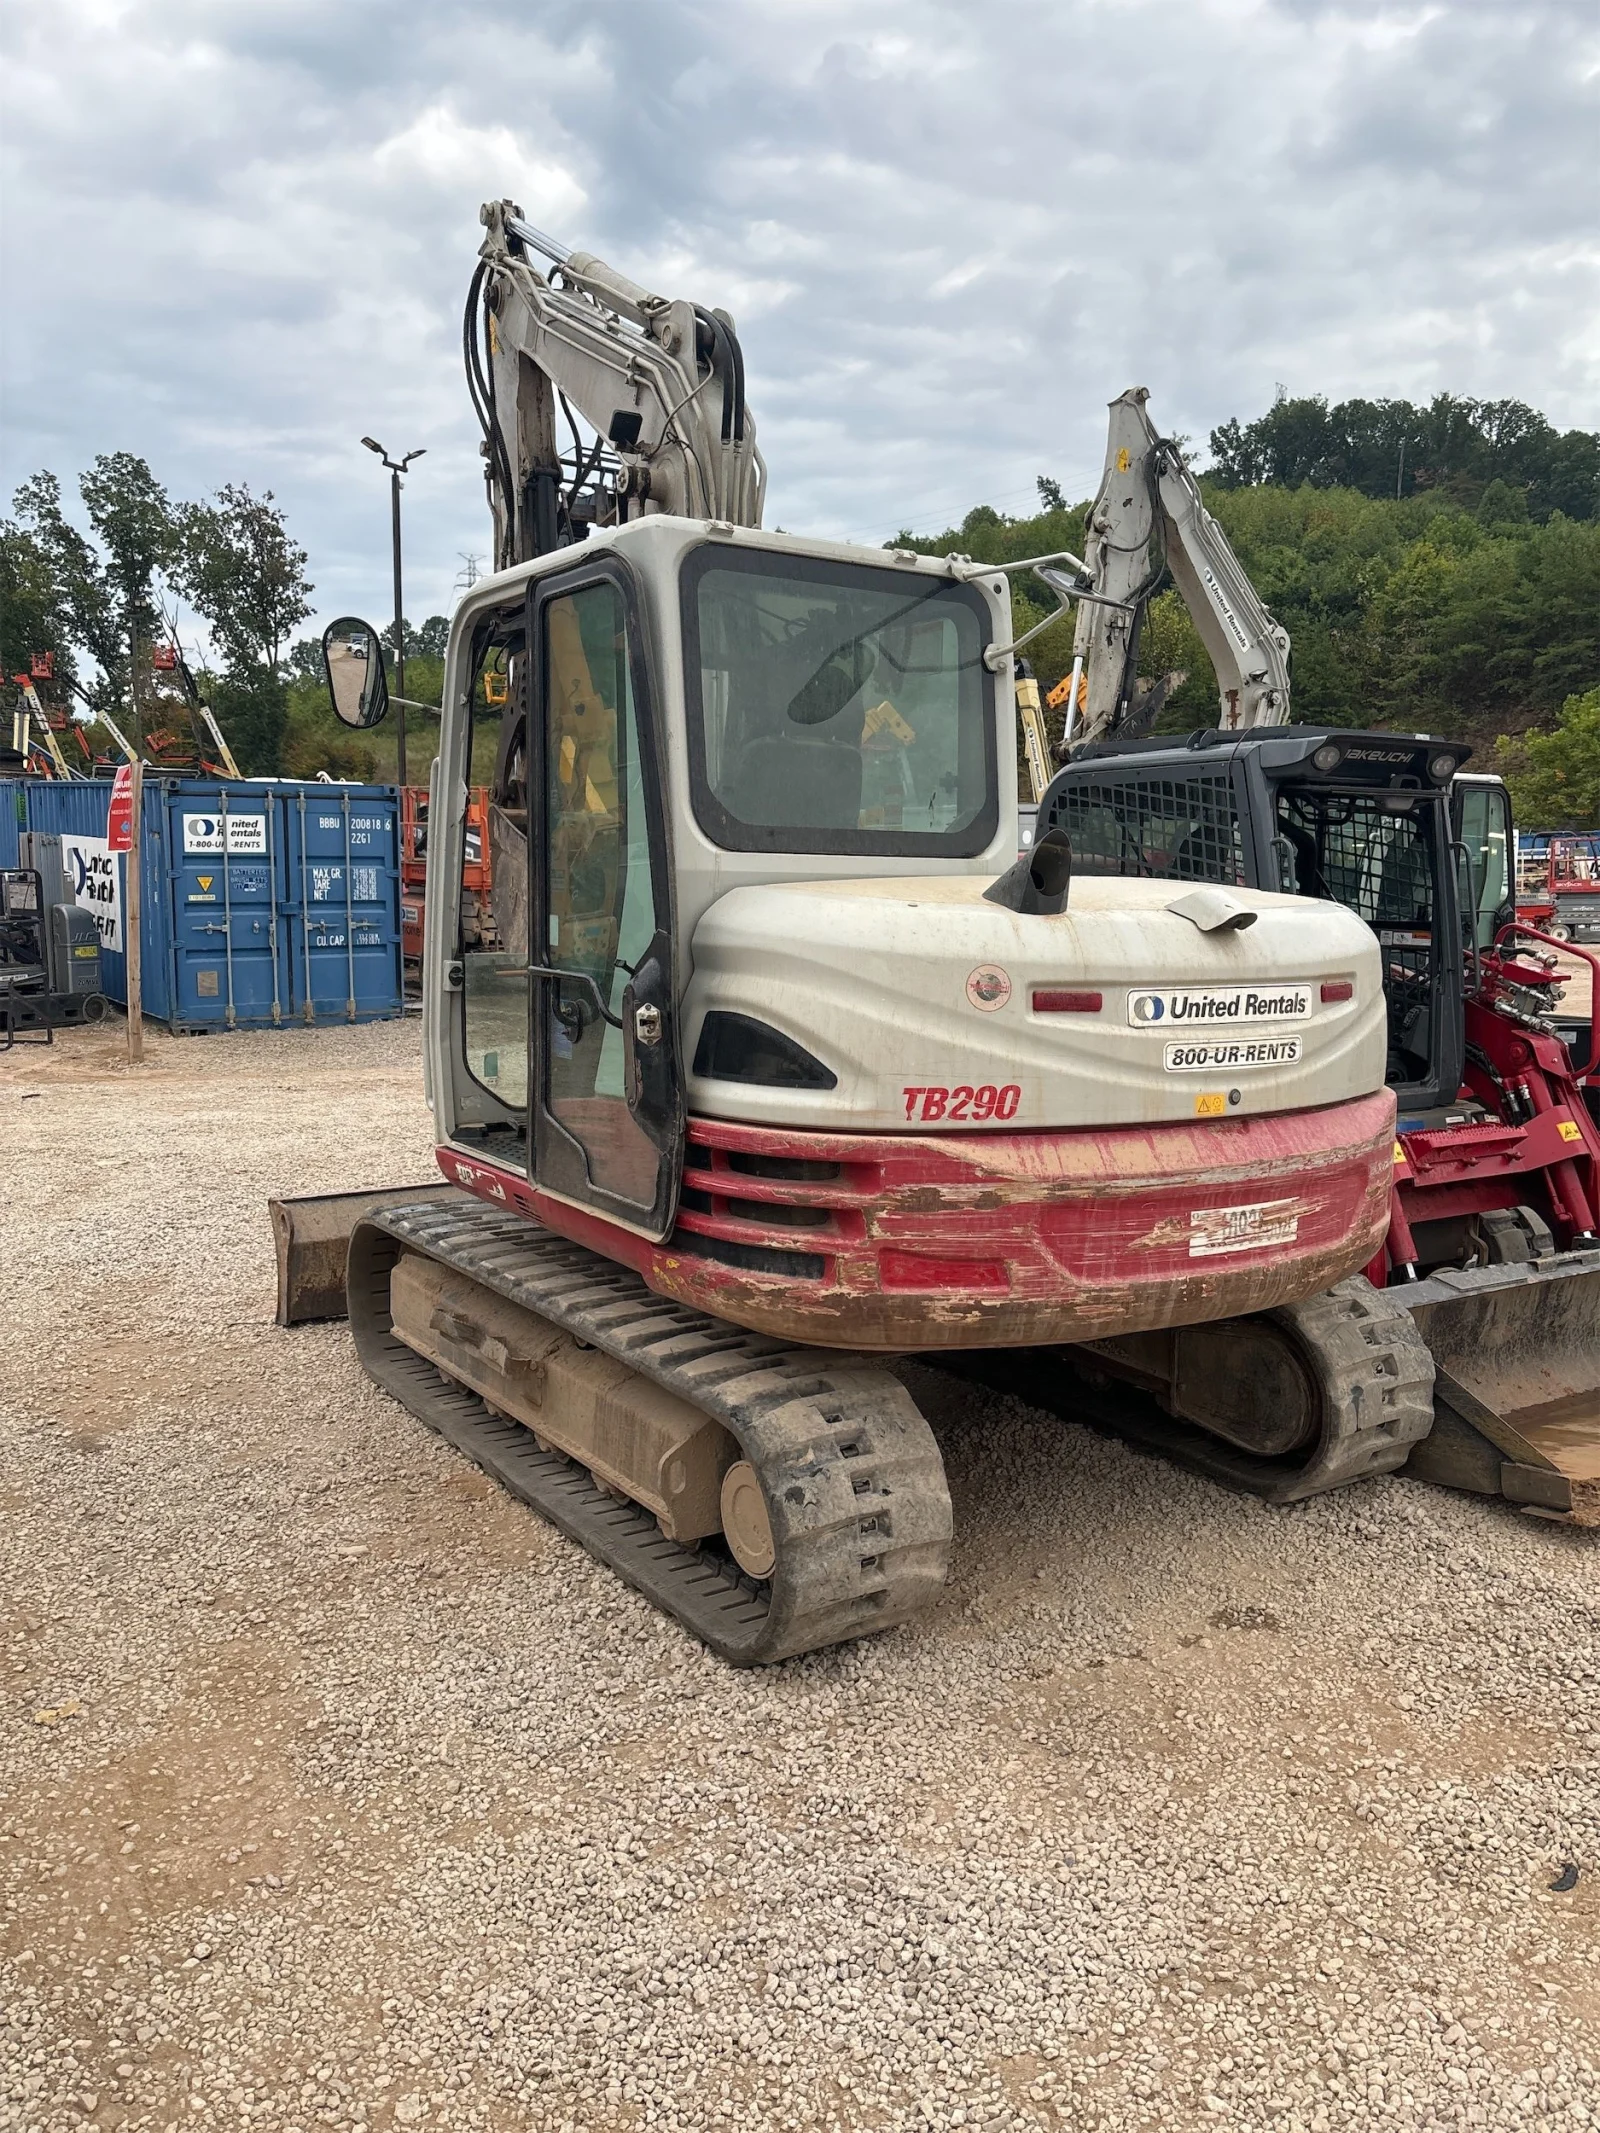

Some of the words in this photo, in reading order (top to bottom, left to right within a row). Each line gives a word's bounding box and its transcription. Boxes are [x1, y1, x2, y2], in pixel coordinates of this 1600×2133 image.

[1211, 583, 1230, 614] United
[1227, 614, 1247, 648] Rentals
[217, 819, 258, 829] United
[319, 817, 340, 829] BBBU
[351, 818, 381, 830] 200818
[384, 820, 391, 830] 6
[217, 828, 262, 837] Rentals
[351, 833, 371, 844] 22G1
[314, 878, 331, 889] TARE
[313, 889, 328, 900] NET
[330, 935, 346, 946] CAP.
[1171, 994, 1240, 1019] United
[1245, 992, 1306, 1015] Rentals
[1172, 1041, 1297, 1066] 800-UR-RENTS
[902, 1084, 1022, 1121] TB290
